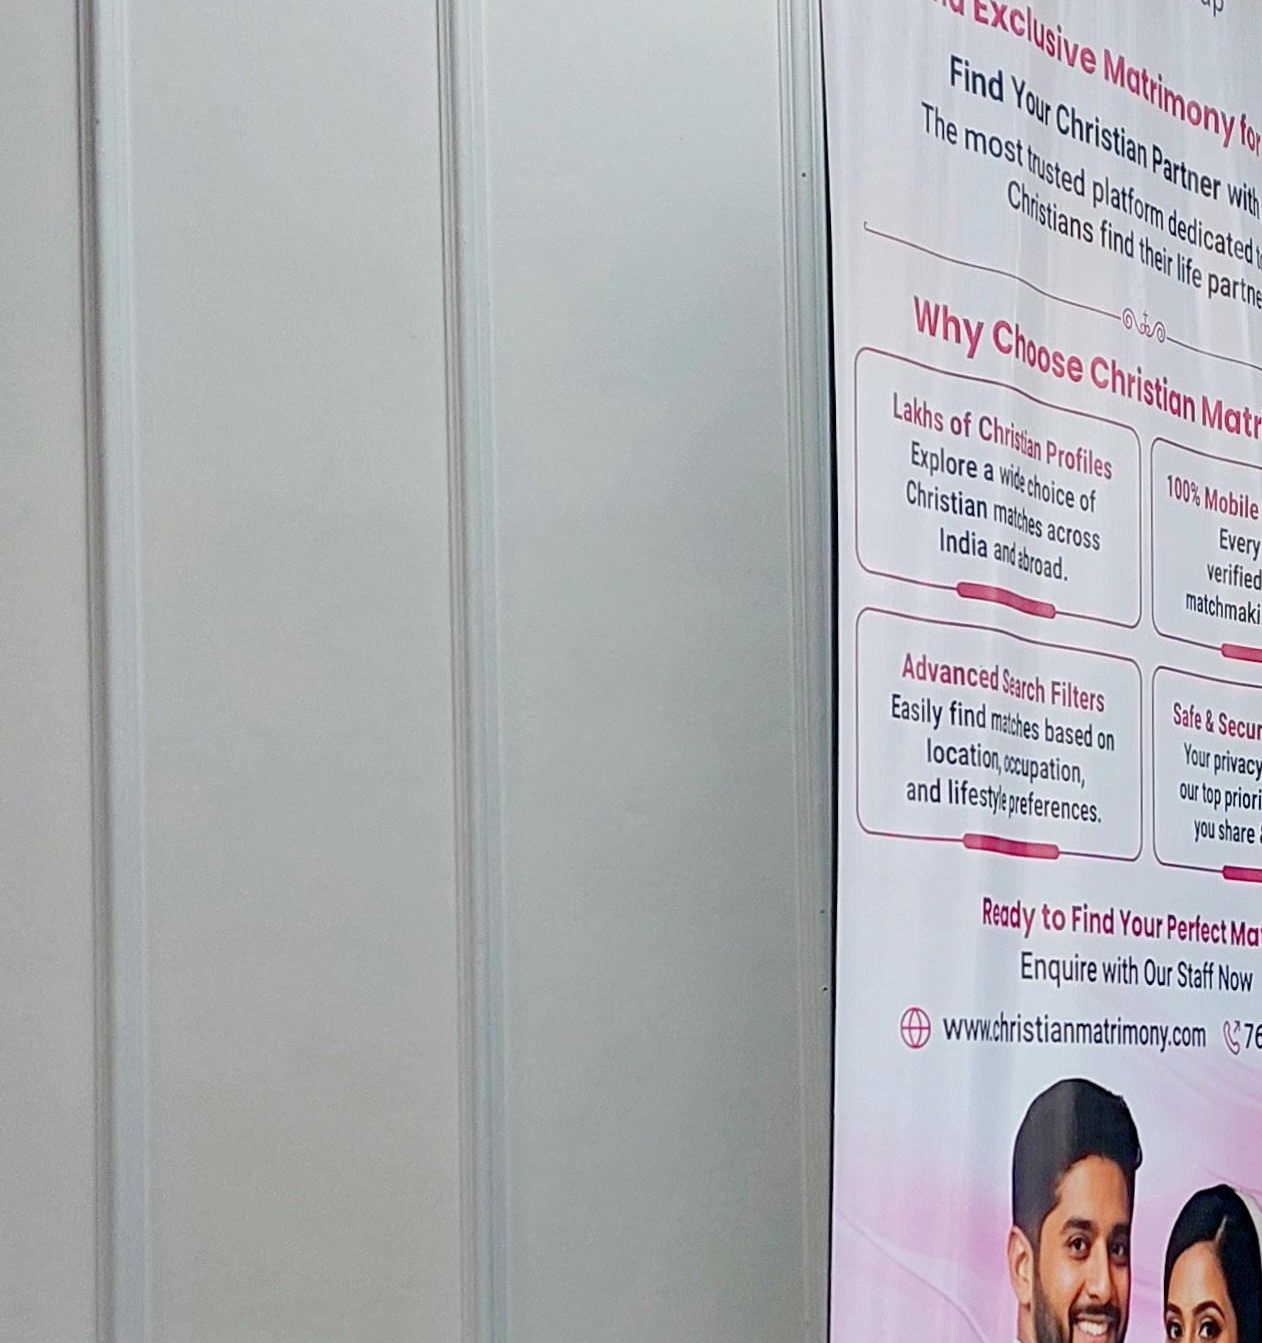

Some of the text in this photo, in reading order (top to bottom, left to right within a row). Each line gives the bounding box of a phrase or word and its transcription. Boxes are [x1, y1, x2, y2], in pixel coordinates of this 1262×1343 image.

[1104, 48, 1235, 149] Matrimony
[1240, 113, 1261, 158] for
[950, 54, 1005, 102] Find
[1010, 74, 1052, 126] Your
[1055, 103, 1148, 170] Christian
[1152, 144, 1222, 201] Partner
[1227, 182, 1260, 219] with
[921, 101, 958, 145] The
[964, 126, 1023, 167] most
[1028, 144, 1085, 198] trusted
[1092, 176, 1164, 231] platform
[1168, 209, 1253, 264] dedicated
[1007, 180, 1094, 243] Christians
[1100, 219, 1135, 259] find
[1139, 236, 1173, 276] their
[1177, 253, 1202, 289] life
[912, 295, 985, 359] Why
[992, 319, 1084, 383] Choose
[1089, 355, 1196, 423] Christian
[893, 392, 1113, 480] Lakhs of Christian Profiles
[911, 440, 1097, 513] Explore a wide choice of
[1166, 474, 1201, 507] 100%
[1204, 486, 1259, 521] Mobile
[906, 479, 1101, 551] Christian matches across
[940, 526, 1069, 581] India and abroad.
[1219, 527, 1261, 561] Every
[1206, 563, 1262, 591] verified
[902, 652, 1105, 712] Advanced Search Filters
[891, 693, 1115, 752] Easily find matches based on
[1173, 701, 1202, 731] Safe
[1205, 709, 1215, 734] &
[926, 737, 1086, 789] location, occupation,
[1183, 742, 1211, 769] Your
[906, 777, 1102, 824] and lifestyle preferences.
[1179, 781, 1199, 803] our
[1202, 782, 1221, 807] top
[1194, 819, 1215, 843] you
[1218, 818, 1255, 845] share
[982, 896, 1036, 939] Ready
[1041, 903, 1066, 932] to
[1071, 903, 1115, 936] Find
[1119, 908, 1163, 940] Your
[1166, 914, 1227, 946] Perfect
[1020, 950, 1254, 993] Enquire with Our Staff Now
[942, 1011, 1207, 1052] www.christianmatrimony.com
